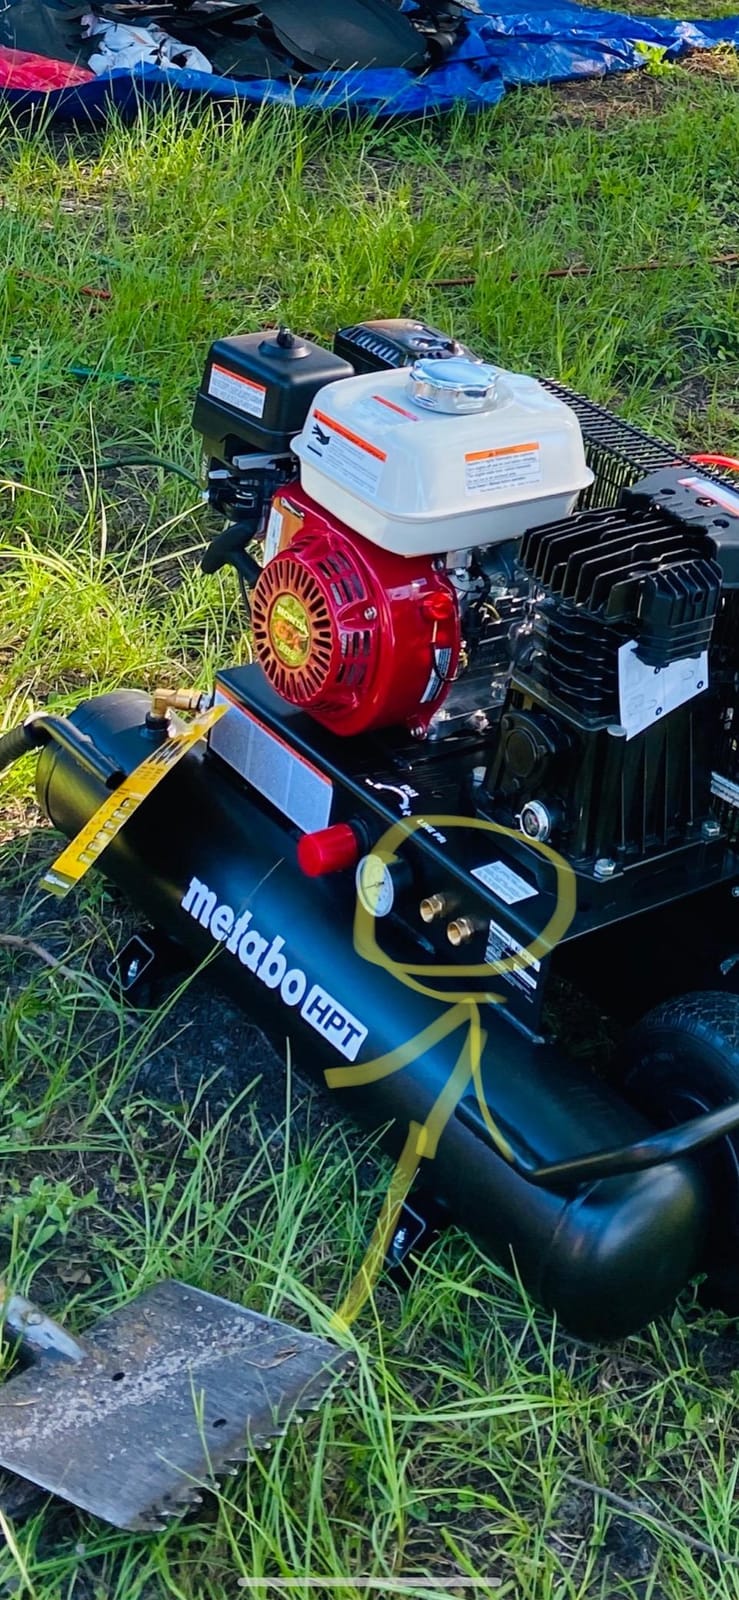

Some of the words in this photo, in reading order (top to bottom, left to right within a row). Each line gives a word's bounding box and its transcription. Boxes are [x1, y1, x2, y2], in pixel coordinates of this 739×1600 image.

[277, 604, 310, 636] HONDA
[181, 876, 306, 1006] metabo
[306, 994, 362, 1048] HPT
